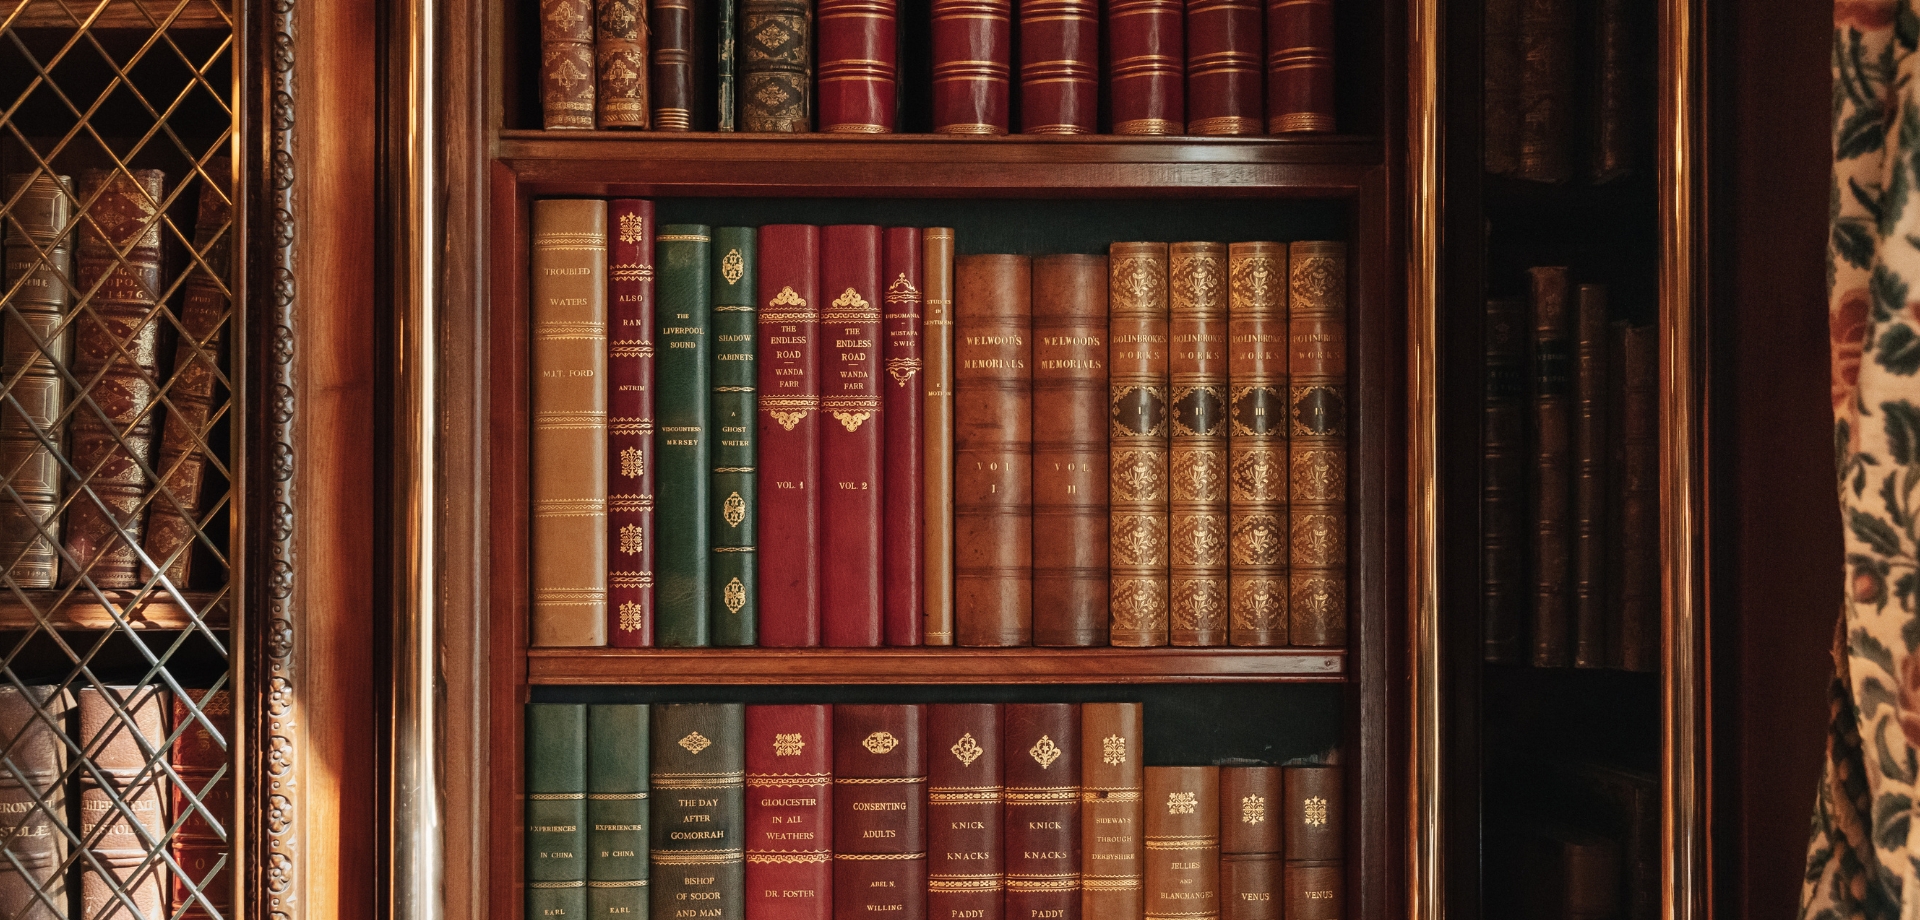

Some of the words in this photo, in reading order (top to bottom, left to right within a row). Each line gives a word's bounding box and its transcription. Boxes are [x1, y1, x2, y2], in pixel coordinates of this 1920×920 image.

[544, 267, 591, 276] TROUBLED
[550, 298, 587, 306] WATERS
[619, 294, 643, 302] ALSO
[663, 327, 705, 335] LIVERPOOL
[781, 325, 797, 333] THE
[718, 334, 752, 342] SHADOW
[770, 336, 807, 344] ENDLESS
[966, 335, 1022, 346] WELWOOD'S
[1044, 335, 1100, 346] WELWOOD'S
[1232, 334, 1285, 343] BOLINBROK
[1293, 333, 1343, 343] BOLINBRO
[836, 340, 872, 348] ENDLESS
[718, 353, 753, 361] CABINETS
[776, 350, 801, 359] ROAD
[841, 353, 866, 361] ROAD
[1119, 351, 1160, 359] WORKS
[1179, 351, 1220, 360] WORKS
[1239, 351, 1279, 360] WORKS
[1299, 351, 1339, 359] WORKS
[964, 359, 1024, 369] MEMORIALS
[1041, 359, 1102, 369] MEMORIALS
[569, 369, 594, 377] FORD
[775, 368, 804, 376] WANDA
[779, 380, 799, 388] FARR
[844, 382, 864, 390] FARR
[1138, 406, 1142, 415] I
[1195, 407, 1203, 416] II
[1255, 407, 1265, 416] III
[776, 481, 796, 489] VOL.
[799, 481, 804, 489] 1
[839, 482, 858, 490] VOL.
[679, 798, 697, 807] THE
[698, 798, 719, 807] DAY
[761, 798, 817, 807] GLOUCESTER
[852, 802, 907, 811] CONSENTING
[683, 815, 711, 823] AFTER
[772, 816, 782, 824] IN
[786, 815, 803, 823] ALL
[951, 821, 985, 829] KNICK
[1029, 821, 1062, 829] KNICK
[670, 830, 724, 840] GOMORRAH
[766, 832, 814, 840] WEATHERS
[862, 830, 896, 838] ADULTS
[947, 852, 990, 860] KNACKS
[1024, 851, 1067, 859] KNACKS
[1171, 861, 1201, 870] JELLIES
[684, 877, 715, 885] BISHOP
[690, 892, 721, 900] SODOR
[765, 890, 780, 898] DR.
[782, 890, 815, 898] FOSTER
[1160, 890, 1214, 899] BLANCMANGES
[1241, 892, 1270, 901] VENUS
[1305, 890, 1333, 899] VENUS
[675, 909, 697, 918] AND
[699, 908, 722, 917] MAN
[951, 909, 985, 918] PADDY
[1031, 909, 1064, 918] PADDY
